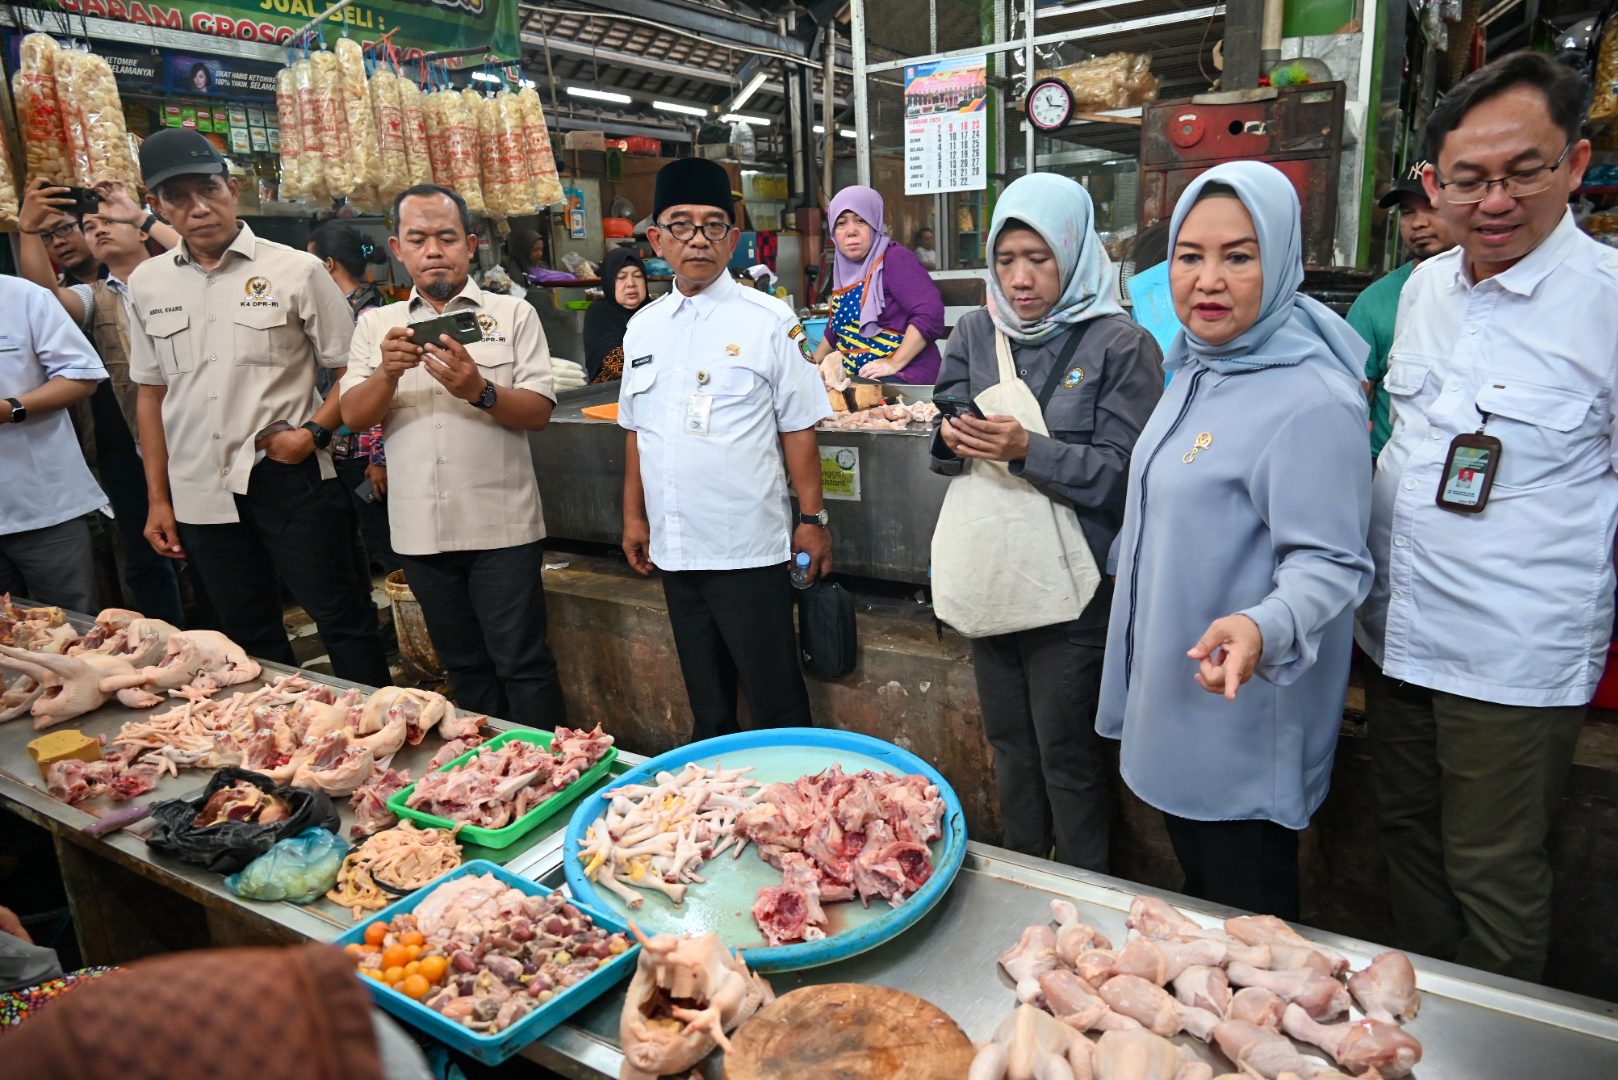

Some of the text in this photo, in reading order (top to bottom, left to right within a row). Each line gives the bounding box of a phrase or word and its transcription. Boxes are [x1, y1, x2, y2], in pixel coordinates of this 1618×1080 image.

[260, 0, 320, 19] JUAL
[960, 121, 968, 130] 16
[972, 120, 980, 129] 23
[949, 132, 957, 141] 10
[960, 131, 968, 140] 17
[972, 130, 980, 138] 24
[949, 142, 957, 150] 11
[960, 140, 968, 149] 18
[972, 140, 980, 148] 25
[949, 152, 957, 160] 12
[960, 150, 968, 158] 19
[972, 149, 980, 158] 26
[949, 160, 957, 168] 13
[960, 159, 968, 168] 20
[972, 158, 980, 166] 27
[949, 169, 957, 178] 14
[960, 168, 968, 177] 21
[972, 167, 980, 176] 28
[949, 178, 957, 187] 15
[960, 178, 968, 186] 22
